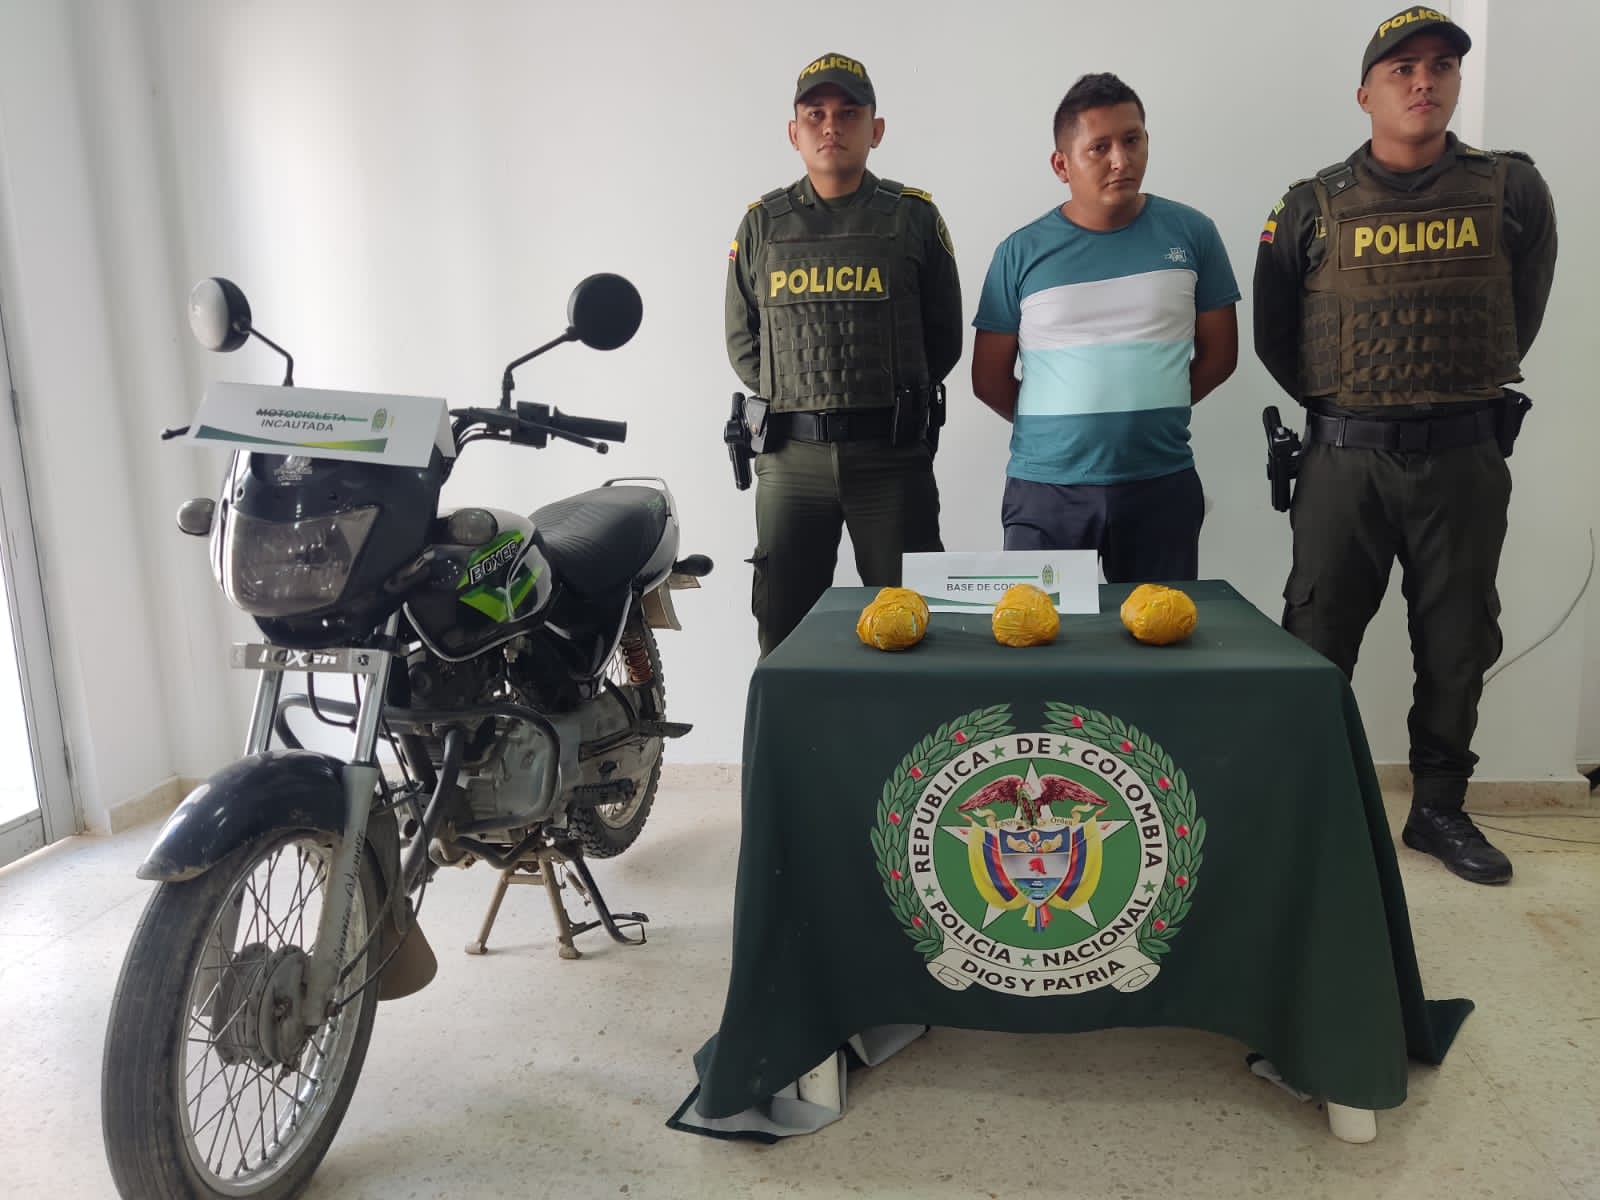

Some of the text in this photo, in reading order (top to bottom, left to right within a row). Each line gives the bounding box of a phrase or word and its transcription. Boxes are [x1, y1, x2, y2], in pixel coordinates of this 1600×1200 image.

[800, 56, 864, 80] POLICIA
[1354, 217, 1479, 257] POLICIA
[770, 266, 883, 297] POLICIA
[256, 408, 347, 422] MOTOCICLETA
[261, 419, 334, 432] INCAUTADA
[470, 540, 520, 585] BOXER
[946, 583, 1015, 592] BASE DE COC
[913, 737, 1163, 874] REPÚBLICA DE COLOMBIA
[1042, 896, 1152, 968] NACIONAL
[960, 959, 1126, 992] DIOS Y PATRIA
